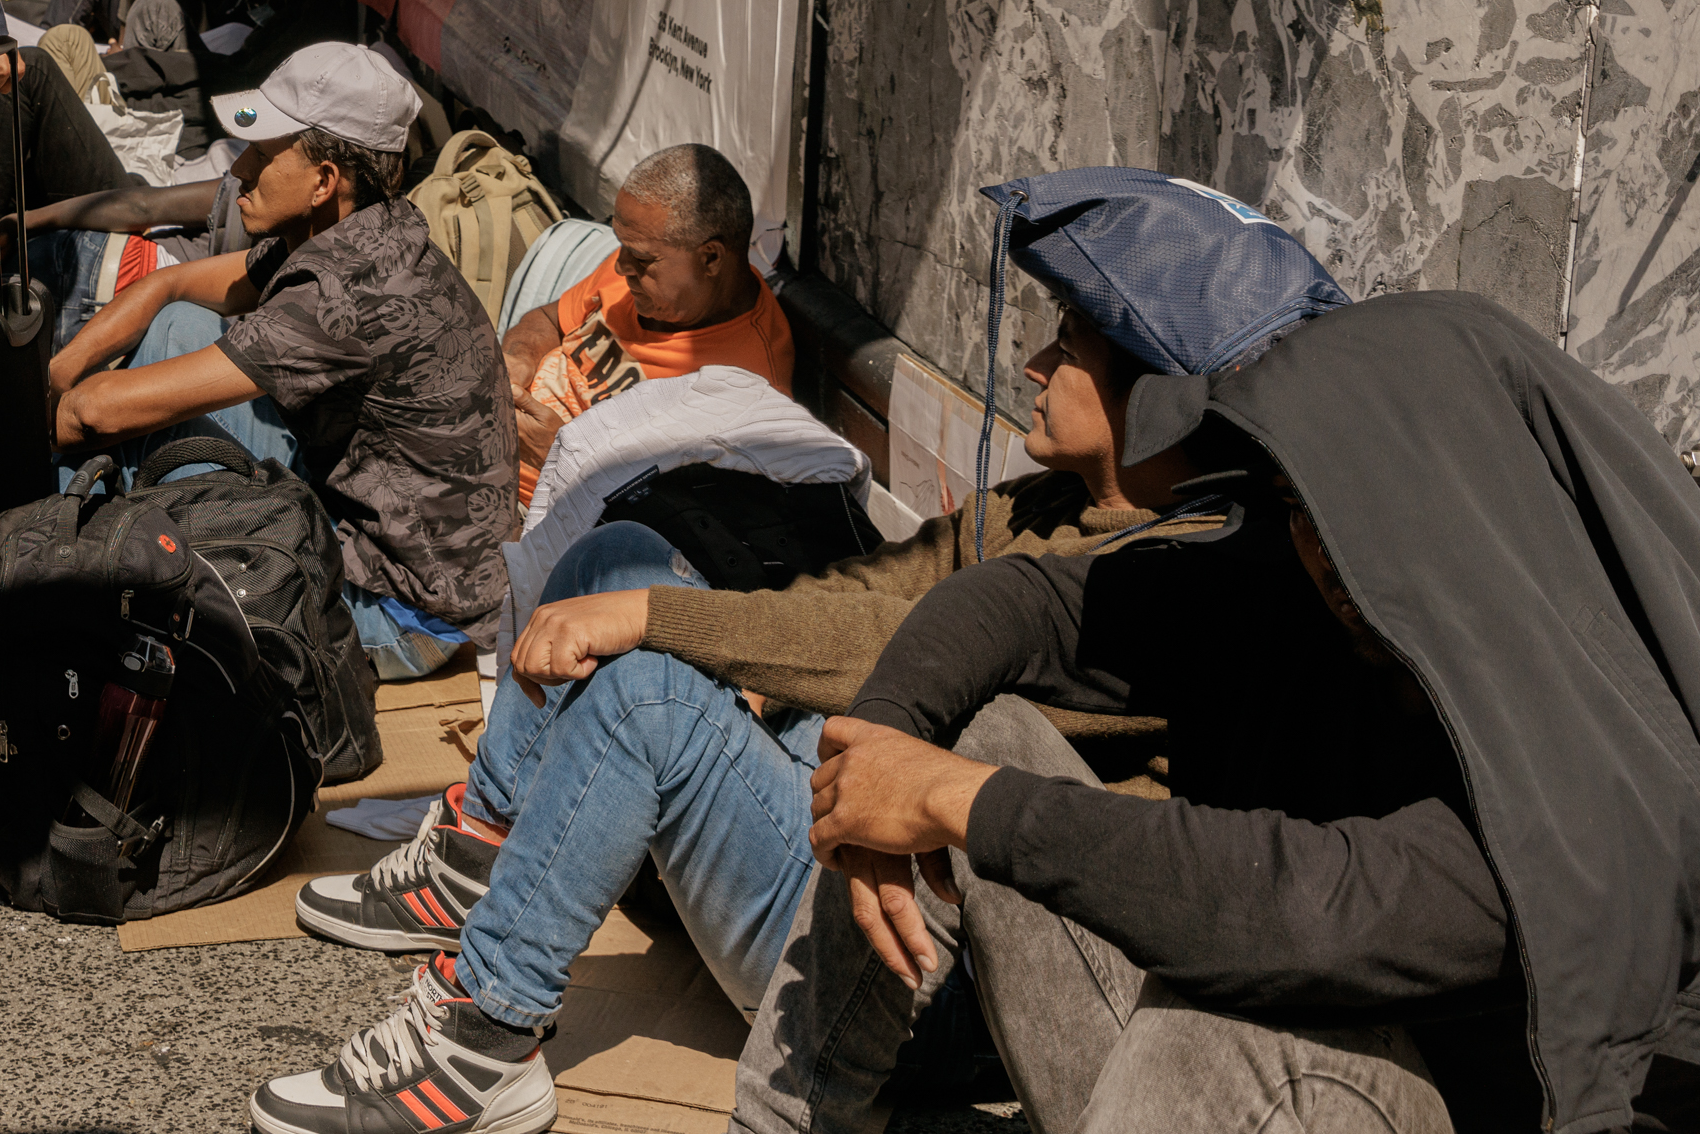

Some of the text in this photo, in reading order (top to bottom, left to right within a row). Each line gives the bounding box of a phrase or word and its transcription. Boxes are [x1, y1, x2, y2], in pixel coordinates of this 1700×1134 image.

[683, 26, 708, 58] Avenue
[649, 36, 712, 95] Brooklyn, New York
